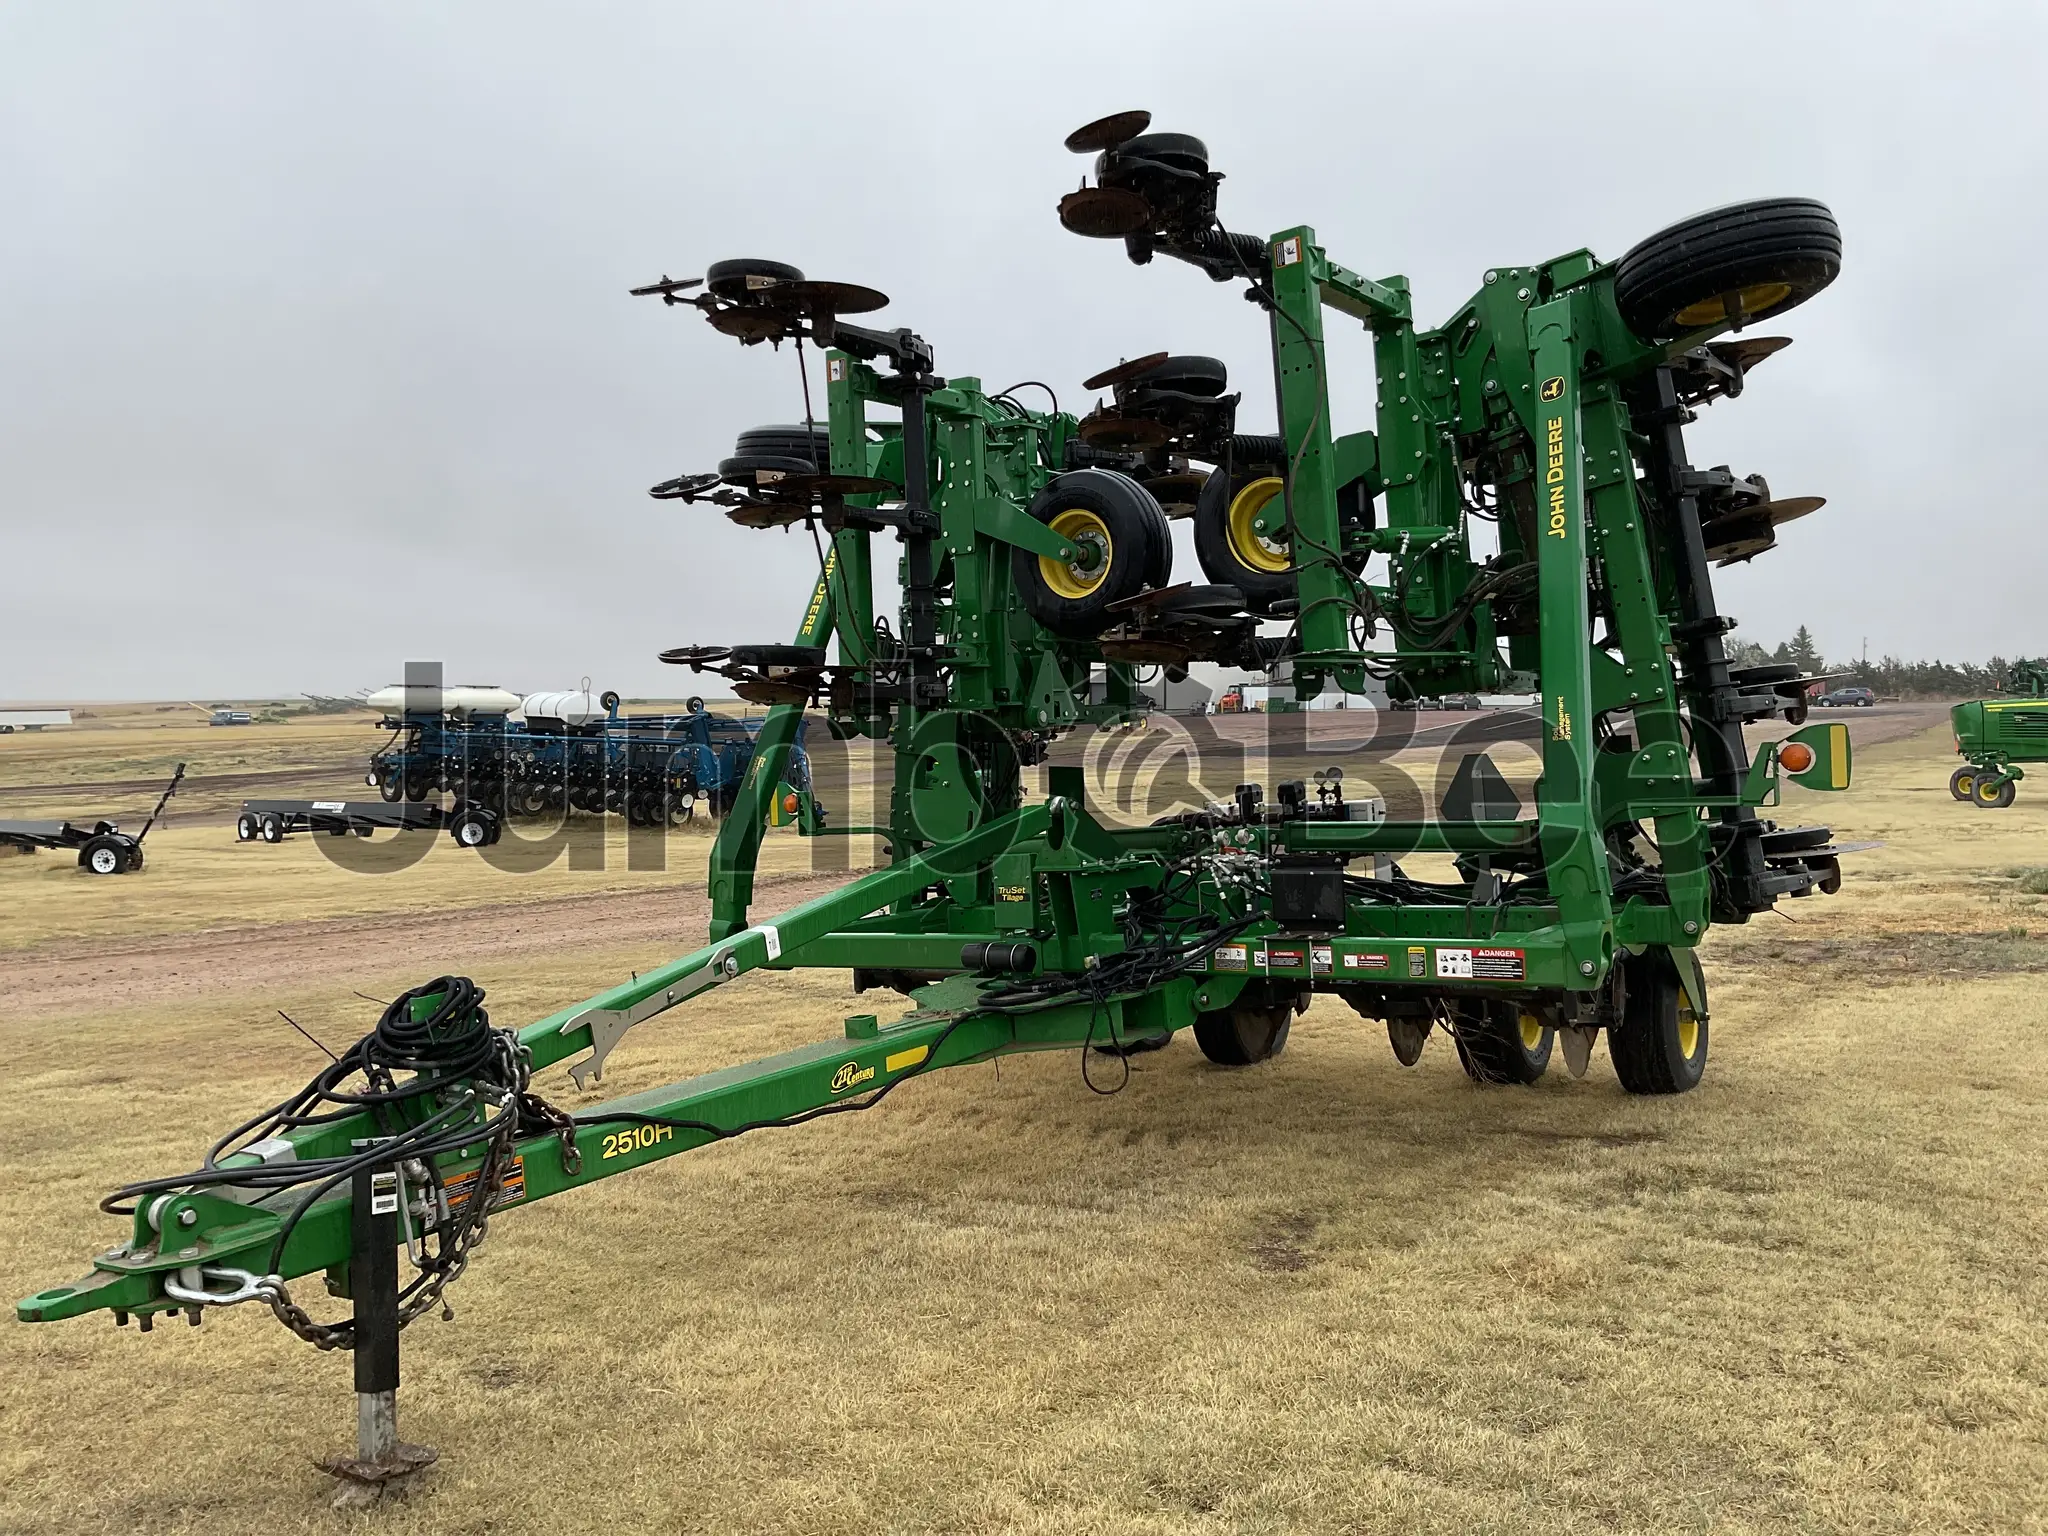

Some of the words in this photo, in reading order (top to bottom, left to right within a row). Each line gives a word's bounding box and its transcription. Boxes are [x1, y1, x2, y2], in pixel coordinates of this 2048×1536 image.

[1546, 416, 1564, 484] DEERE
[1547, 485, 1566, 539] JOHN
[802, 583, 827, 635] DEERE
[998, 886, 1026, 895] TruSet
[1001, 894, 1024, 902] Tillage
[602, 1123, 673, 1160] 2510H
